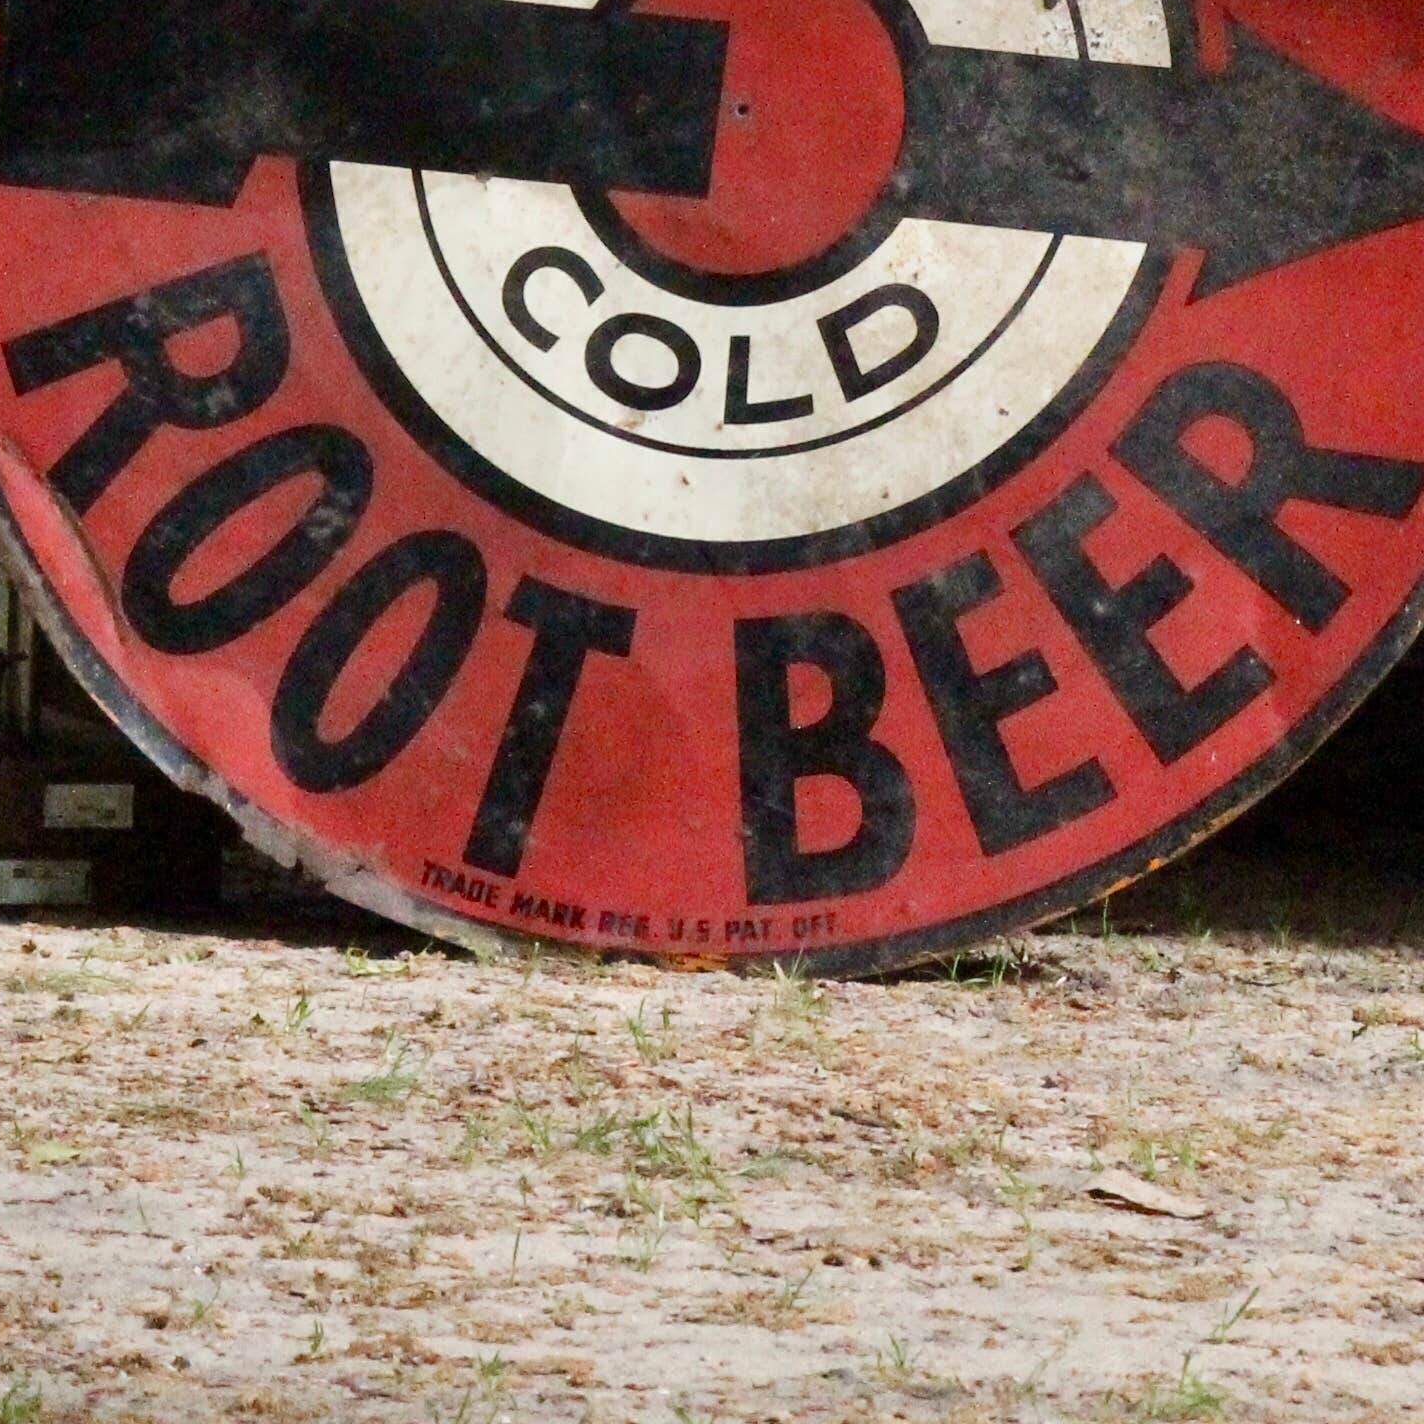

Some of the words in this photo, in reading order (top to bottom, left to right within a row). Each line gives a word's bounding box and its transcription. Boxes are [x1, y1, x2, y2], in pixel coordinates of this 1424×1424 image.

[502, 245, 940, 425] COLD
[1, 249, 638, 879] ROOT
[421, 859, 503, 908] TRADE
[509, 890, 587, 931] MARK
